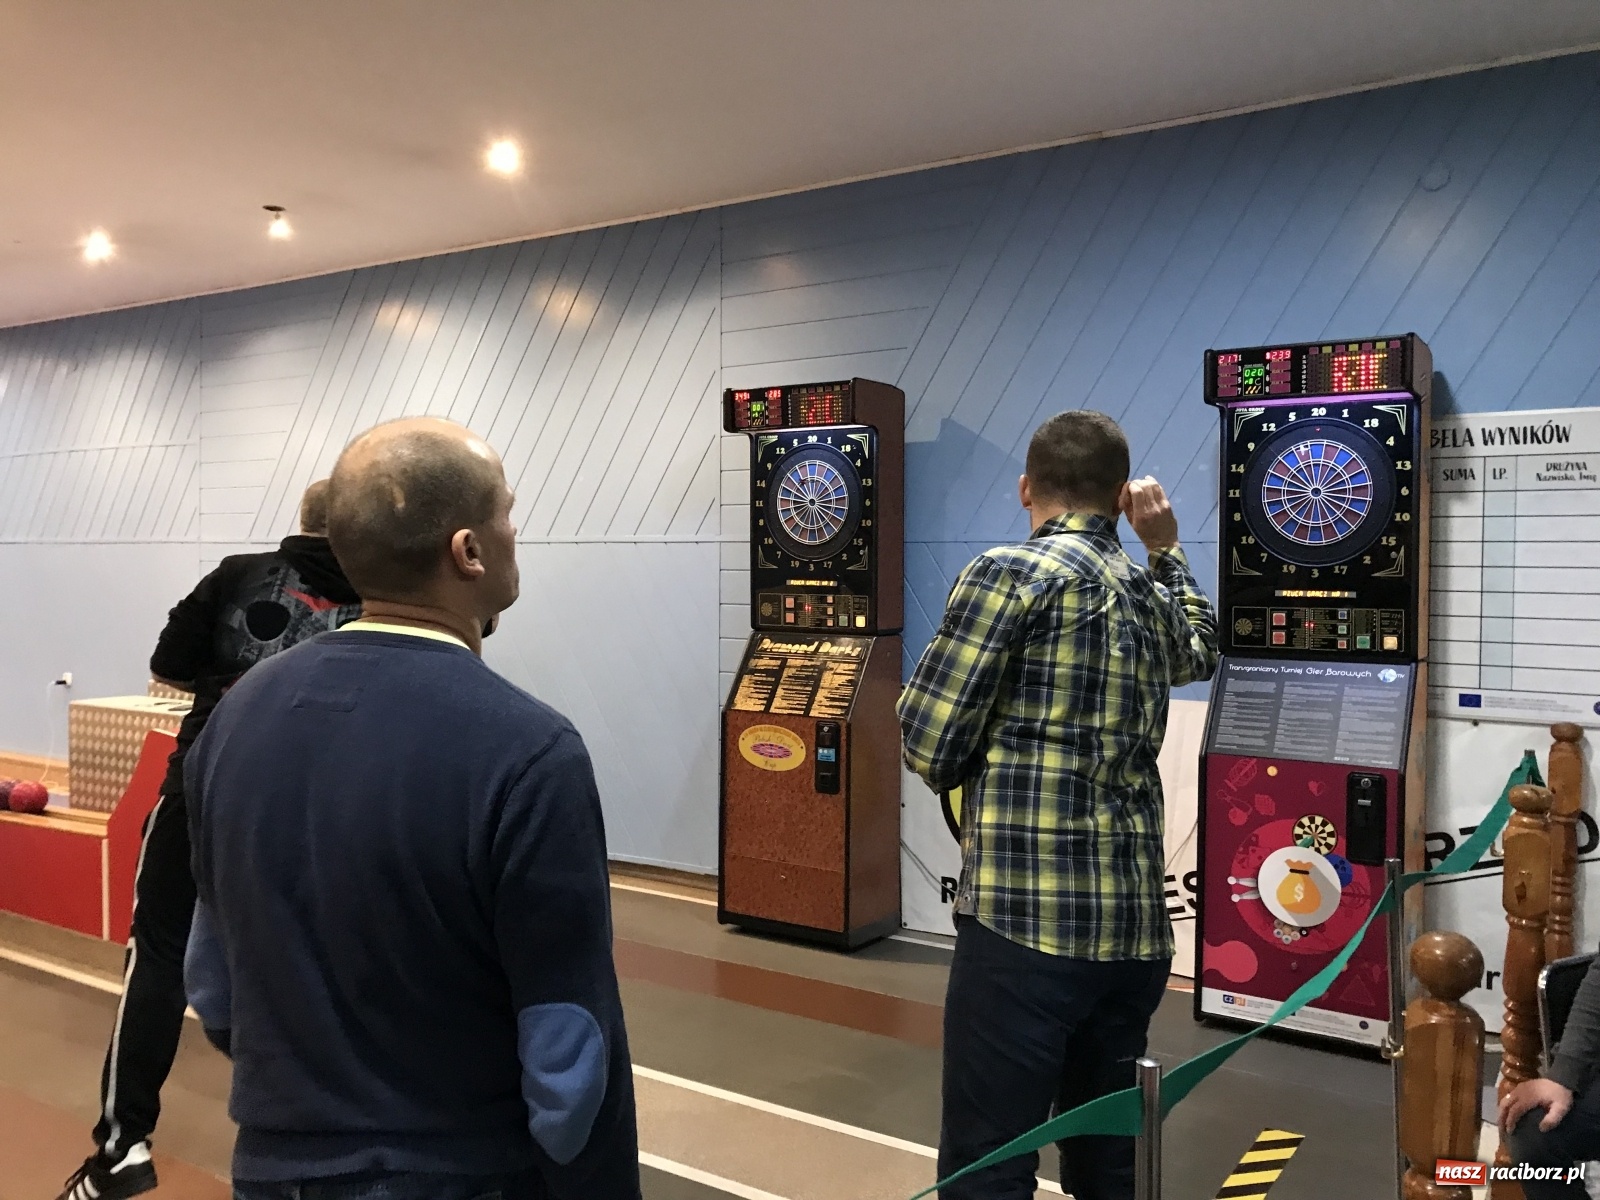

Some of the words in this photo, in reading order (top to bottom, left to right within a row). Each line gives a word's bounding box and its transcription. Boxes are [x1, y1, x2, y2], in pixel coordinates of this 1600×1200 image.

[1219, 354, 1238, 364] 217
[1272, 350, 1291, 359] 239
[1244, 369, 1264, 377] 020
[1311, 407, 1327, 416] 20
[1342, 409, 1349, 417] 1
[1288, 412, 1296, 421] 5
[1262, 423, 1276, 431] 12
[1363, 418, 1379, 428] 18
[1481, 420, 1572, 446] WYNIKÓW
[1386, 436, 1394, 446] 4
[1248, 442, 1255, 451] 9
[1231, 464, 1245, 473] 14
[1396, 460, 1411, 470] 13
[1443, 468, 1476, 481] SUMA
[1493, 468, 1508, 480] LP.
[1228, 489, 1240, 497] 11
[1401, 486, 1409, 496] 6
[1234, 513, 1241, 521] 8
[1395, 513, 1410, 521] 10
[1240, 536, 1255, 544] 16
[1381, 536, 1397, 546] 15
[1260, 553, 1268, 562] 7
[1363, 556, 1371, 564] 2
[1282, 564, 1296, 574] 19
[1311, 568, 1319, 578] 3
[1334, 566, 1348, 574] 17
[1325, 668, 1372, 678] Barowych
